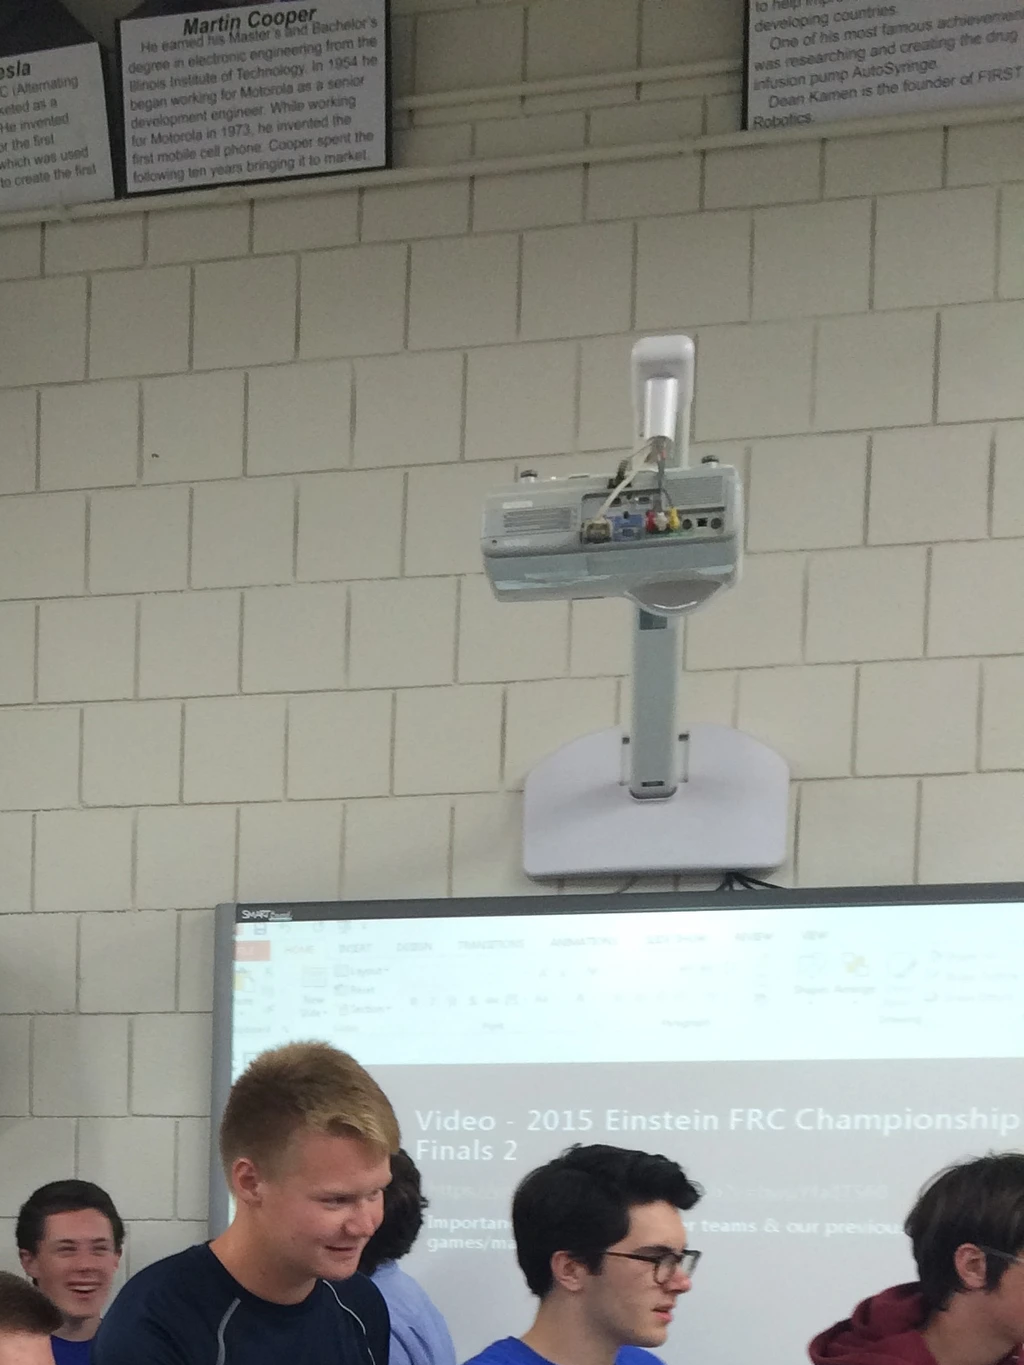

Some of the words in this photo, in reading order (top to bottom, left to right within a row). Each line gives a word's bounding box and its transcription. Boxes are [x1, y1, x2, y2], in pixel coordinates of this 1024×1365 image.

[141, 41, 158, 53] He
[207, 32, 225, 46] his
[284, 25, 308, 38] and
[312, 16, 377, 35] Bachelor's
[183, 13, 241, 36] Martin
[247, 9, 317, 29] Cooper
[754, 13, 829, 32] developing
[128, 61, 170, 76] degree
[174, 58, 184, 70] in
[188, 51, 247, 68] electronic
[250, 43, 322, 62] engineering
[326, 39, 354, 51] from
[357, 36, 377, 48] the
[754, 58, 781, 72] was
[784, 48, 867, 68] researching
[870, 41, 897, 57] and
[899, 36, 956, 52] creating
[959, 32, 982, 47] the
[985, 30, 1019, 45] drug
[130, 98, 168, 112] began
[170, 92, 218, 106] working
[220, 88, 237, 101] for
[239, 83, 294, 98] Motorola
[297, 82, 312, 94] as
[327, 76, 364, 90] senior
[753, 75, 806, 91] infusion
[809, 69, 849, 87] pump
[768, 94, 805, 109] Dean
[808, 88, 857, 103] Kamen
[862, 86, 873, 97] is
[876, 82, 899, 97] the
[903, 75, 956, 93] founder
[959, 71, 974, 86] of
[977, 65, 1024, 83] FIRST
[131, 111, 207, 130] development
[270, 100, 305, 114] While
[307, 96, 356, 110] working
[33, 152, 57, 165] was
[60, 145, 89, 162] used
[131, 152, 154, 165] first
[157, 148, 197, 163] mobile
[200, 145, 220, 160] cell
[269, 138, 312, 153] Cooper
[317, 132, 351, 148] spent
[354, 131, 374, 143] the
[0, 176, 12, 189] to
[14, 171, 51, 187] create
[53, 168, 72, 181] the
[75, 162, 97, 177] first
[133, 168, 185, 183] following
[188, 166, 207, 179] ten
[210, 163, 242, 178] years
[246, 158, 295, 173] bringing
[309, 154, 321, 166] to
[241, 909, 271, 919] SMART
[414, 1109, 496, 1131] Video
[527, 1109, 594, 1131] 2015
[606, 1109, 719, 1131] Einstein
[730, 1108, 786, 1131] FRC
[795, 1107, 1019, 1137] Championship
[415, 1140, 494, 1161] Finals
[503, 1140, 518, 1161] 2
[702, 1219, 757, 1233] teams
[764, 1218, 779, 1233] &
[788, 1222, 818, 1233] our
